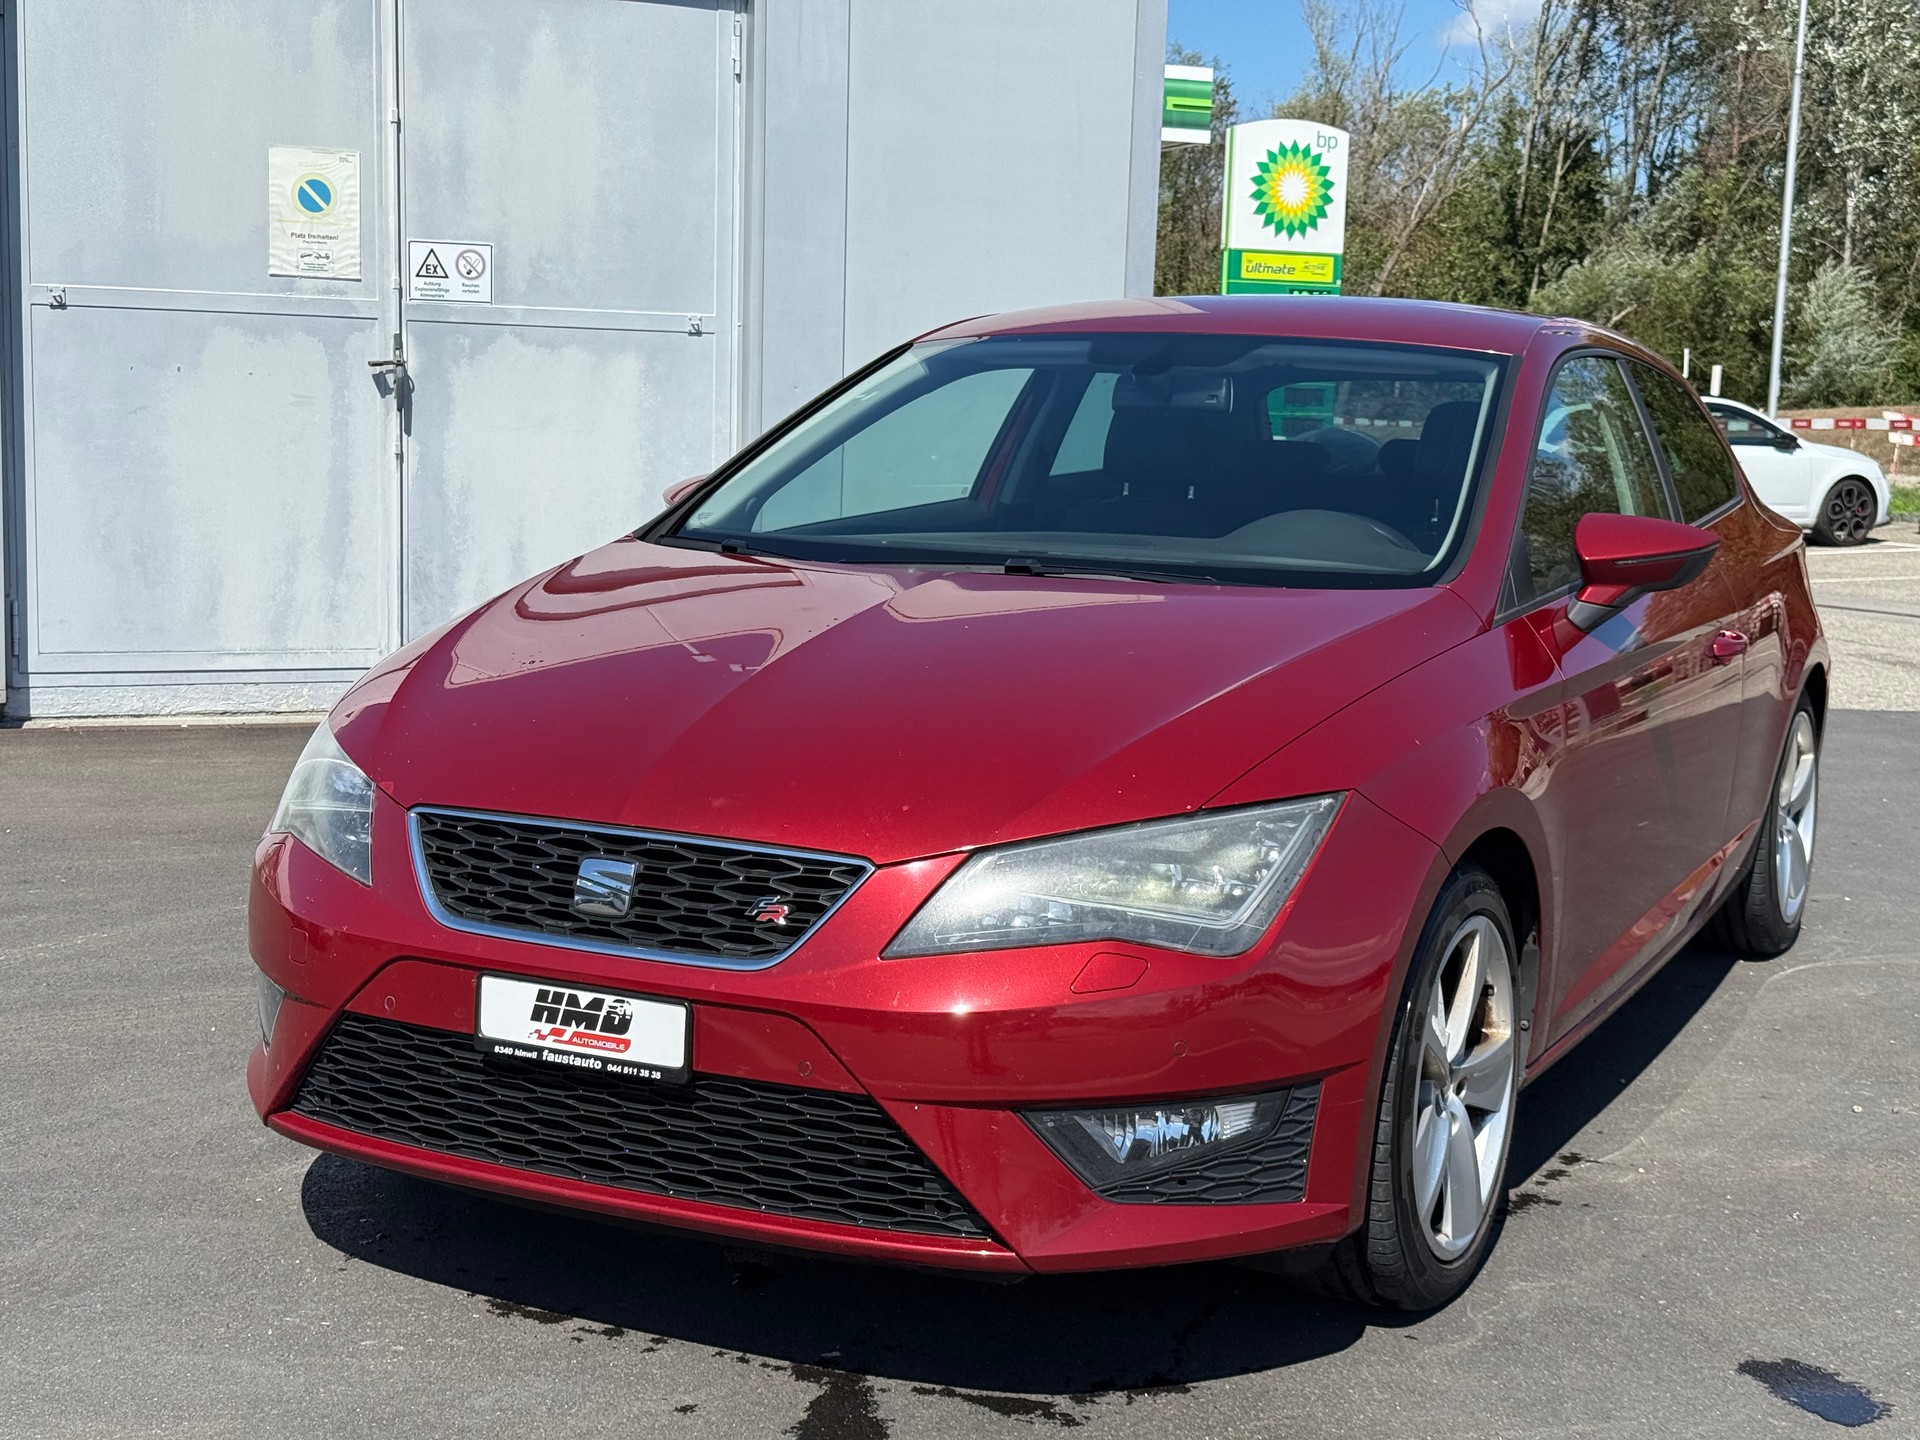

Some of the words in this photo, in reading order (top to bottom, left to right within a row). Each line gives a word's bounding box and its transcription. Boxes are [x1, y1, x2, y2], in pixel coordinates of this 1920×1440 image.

[1316, 130, 1338, 153] bp
[307, 233, 339, 241] freihalten!
[425, 264, 439, 275] EX
[1245, 262, 1296, 275] ultimate
[744, 895, 789, 925] FR
[571, 1036, 626, 1051] AUTOMOBILE
[494, 1045, 514, 1055] 8340
[542, 1049, 602, 1069] faustauto
[607, 1063, 622, 1073] 044
[623, 1066, 638, 1075] 511
[639, 1069, 649, 1078] 35
[651, 1071, 662, 1079] 35
